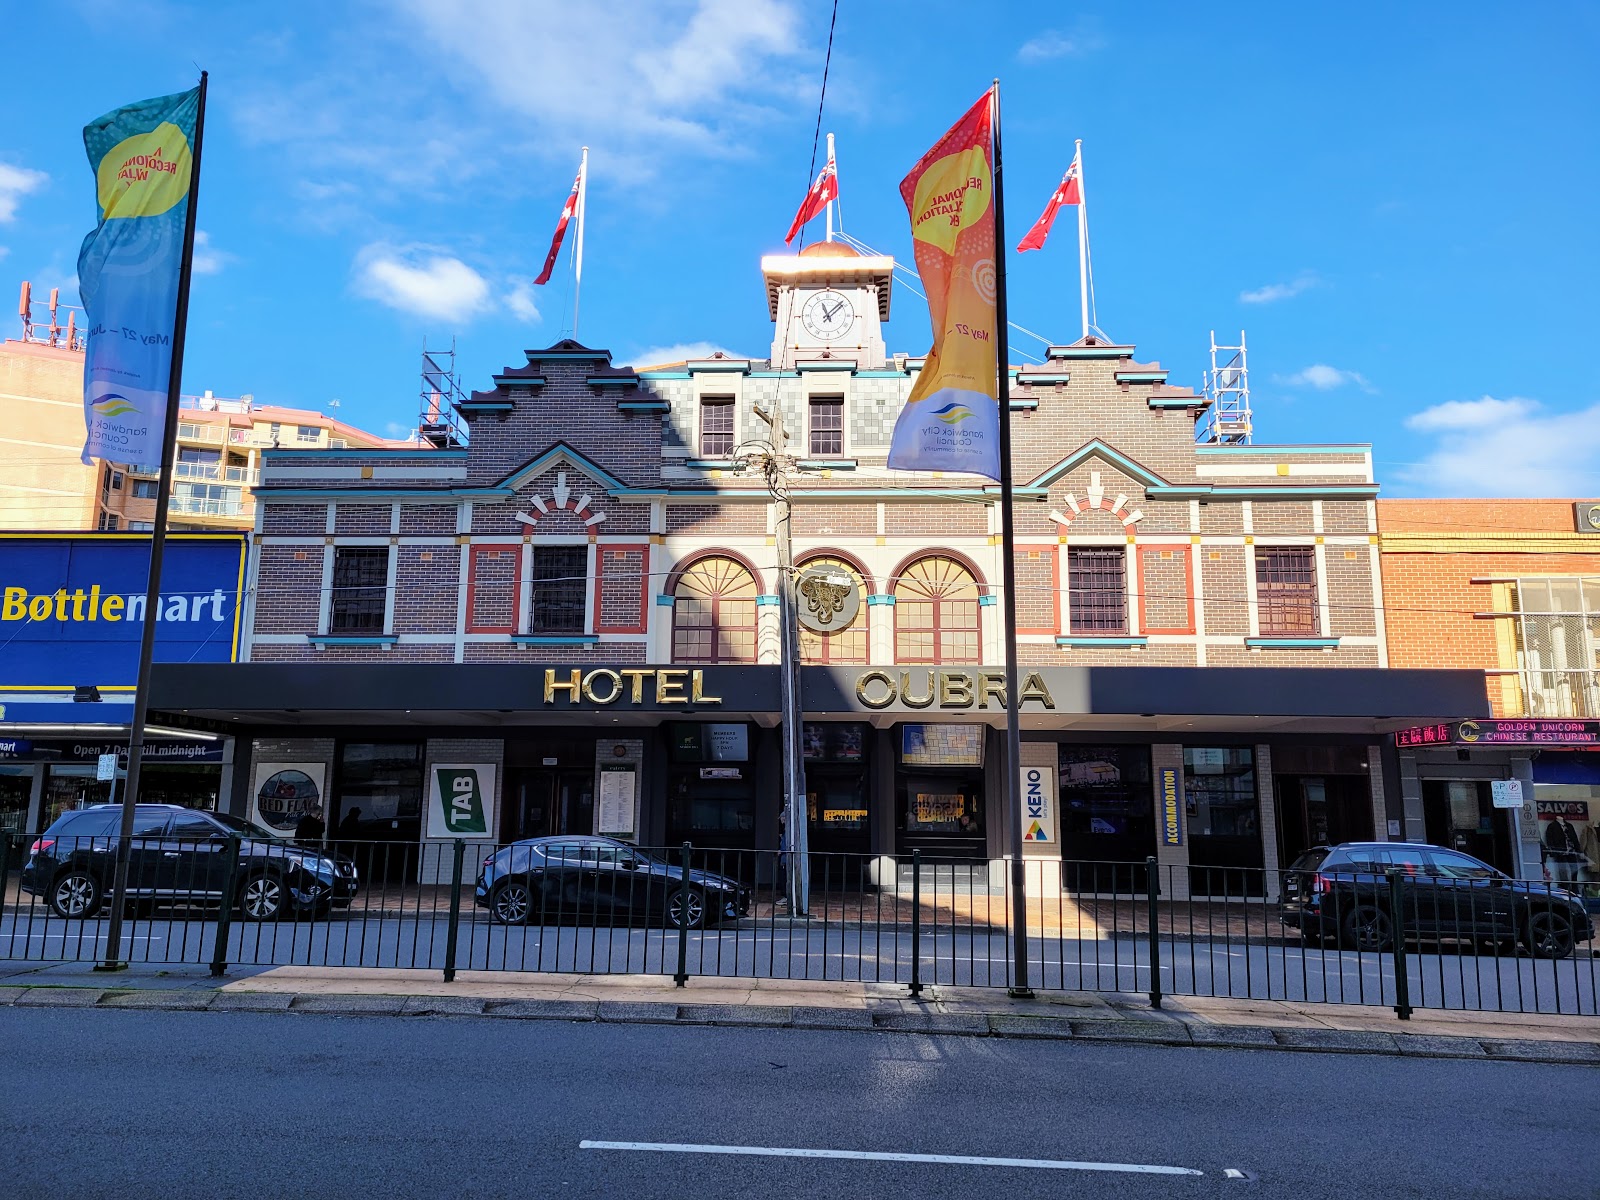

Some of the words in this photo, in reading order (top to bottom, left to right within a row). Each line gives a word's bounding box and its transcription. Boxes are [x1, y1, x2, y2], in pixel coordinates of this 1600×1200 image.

[1, 585, 226, 623] Bottlemart
[544, 668, 722, 705] HOTEL
[855, 669, 1056, 710] OUBRA
[1486, 732, 1528, 741] CHINESE
[1535, 732, 1597, 742] RESTAURANT
[1497, 722, 1536, 732] GOLDEN
[1542, 722, 1585, 732] UNICORN
[73, 744, 101, 757] Open
[104, 744, 110, 755] 7
[141, 744, 156, 755] till
[158, 744, 207, 758] midnight
[259, 797, 284, 812] RED
[450, 775, 474, 825] TAB
[1027, 769, 1042, 818] KENO
[1163, 770, 1179, 844] ACCOMMODATION
[1537, 802, 1584, 814] SALVOS
